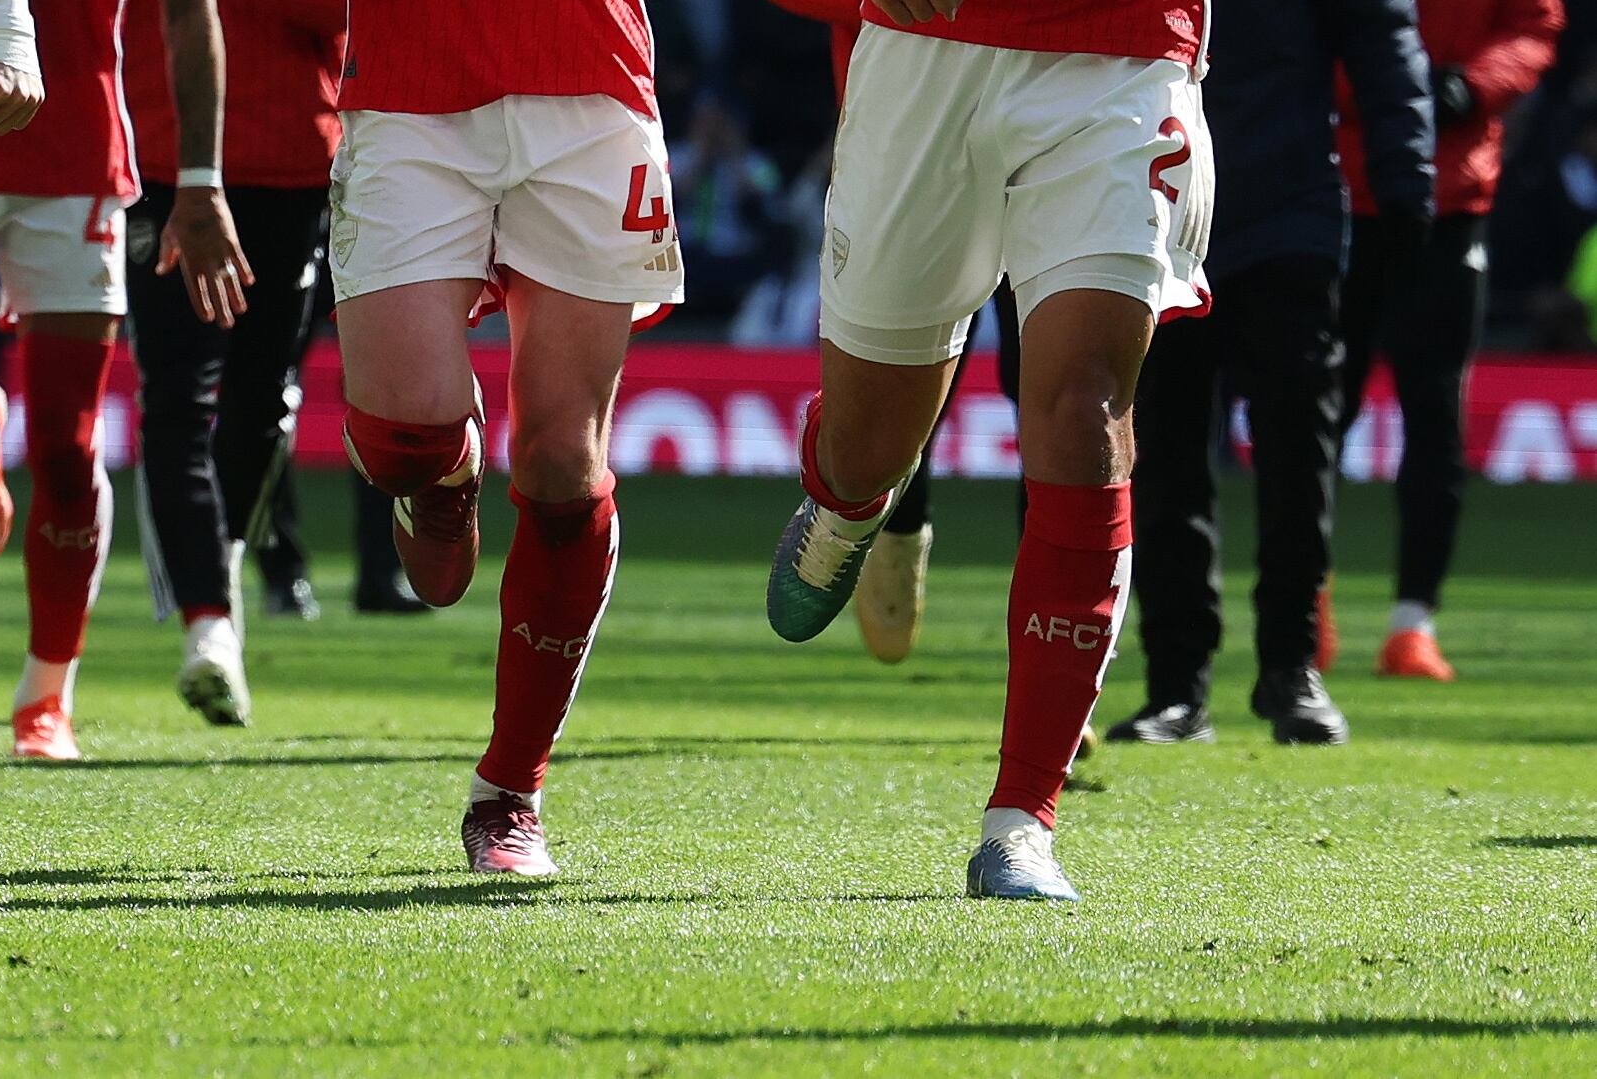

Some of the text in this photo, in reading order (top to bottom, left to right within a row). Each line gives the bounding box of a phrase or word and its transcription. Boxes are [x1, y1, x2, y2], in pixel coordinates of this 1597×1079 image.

[1148, 115, 1191, 205] 2
[621, 163, 670, 245] 4
[512, 622, 587, 659] AFC
[1024, 612, 1101, 651] AFC
